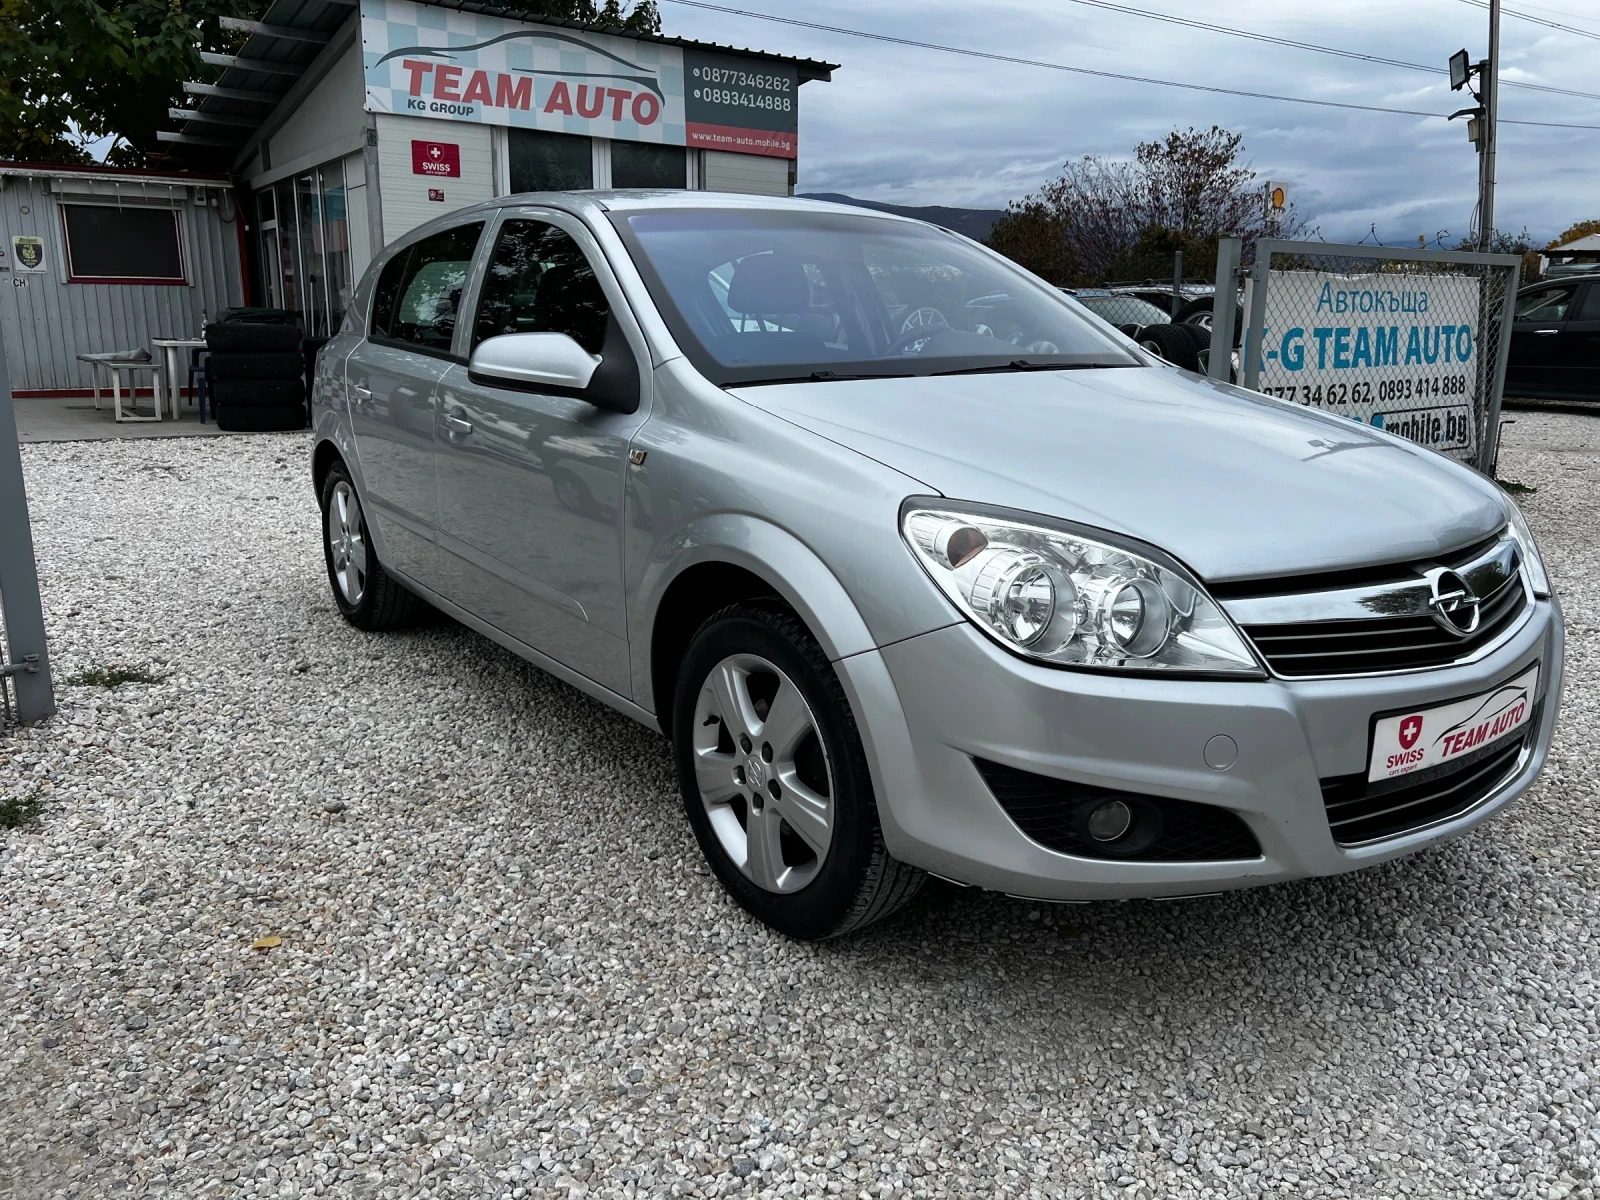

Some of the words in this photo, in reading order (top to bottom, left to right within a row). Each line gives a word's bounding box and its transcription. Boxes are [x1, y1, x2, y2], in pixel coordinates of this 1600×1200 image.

[703, 66, 790, 92] 0877346262
[403, 59, 533, 111] TEAM
[544, 81, 660, 126] AUTO
[703, 87, 791, 112] 0893414888
[407, 99, 426, 111] KG
[430, 102, 474, 116] GROUP
[692, 132, 790, 150] www.team-auto.mobile.bg
[422, 161, 451, 172] SWISS
[13, 278, 26, 287] CH
[1317, 281, 1428, 319] Автокъща
[1313, 326, 1399, 370] TEAM
[1404, 324, 1472, 365] AUTO
[1301, 384, 1323, 406] 34
[1327, 383, 1347, 405] 62
[1351, 382, 1375, 406] 62,
[1379, 379, 1412, 401] 0893
[1415, 377, 1439, 398] 414
[1442, 374, 1466, 395] 888
[1442, 721, 1490, 758] TEAM
[1489, 701, 1525, 739] AUTO
[1386, 748, 1424, 769] SWISS
[1389, 768, 1400, 776] cars
[1400, 763, 1418, 774] export
